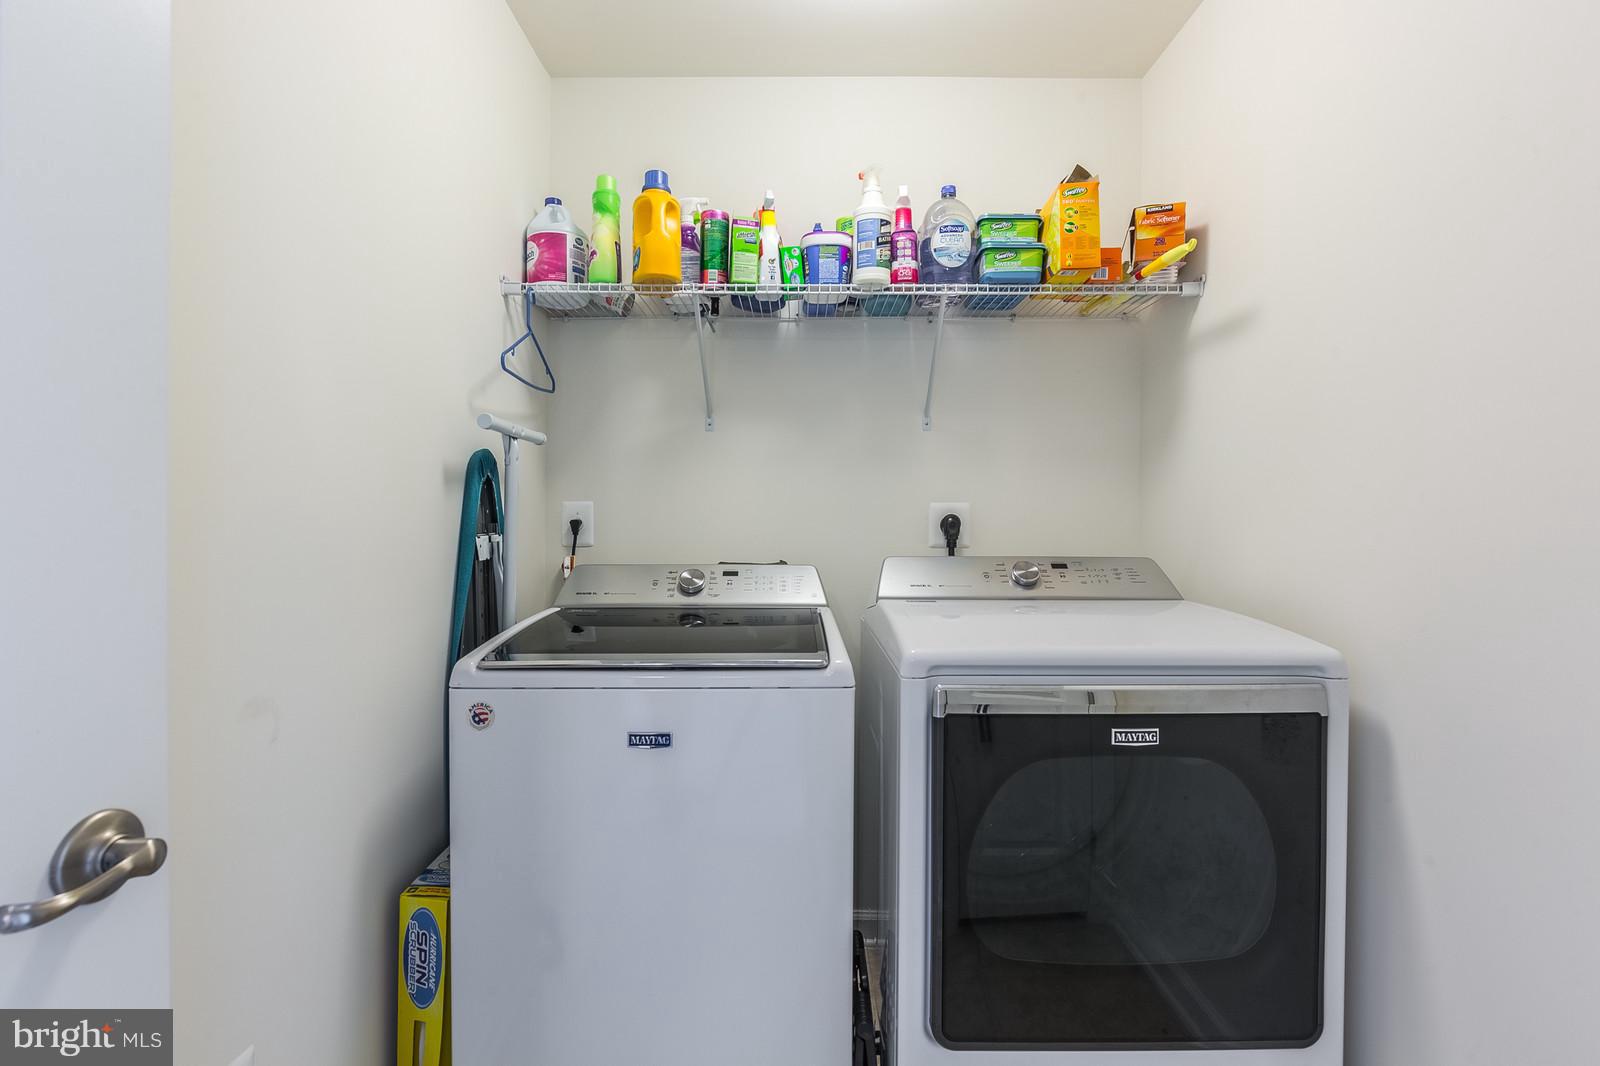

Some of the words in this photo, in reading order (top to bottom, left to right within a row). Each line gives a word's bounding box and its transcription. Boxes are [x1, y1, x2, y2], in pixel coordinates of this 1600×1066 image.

[940, 225, 964, 233] Softsoap
[630, 735, 670, 745] MAYTAG
[1115, 732, 1157, 742] MAYTAG
[408, 919, 418, 998] SCRUBBER
[415, 930, 429, 989] SPIN
[428, 931, 438, 994] HURRICANE
